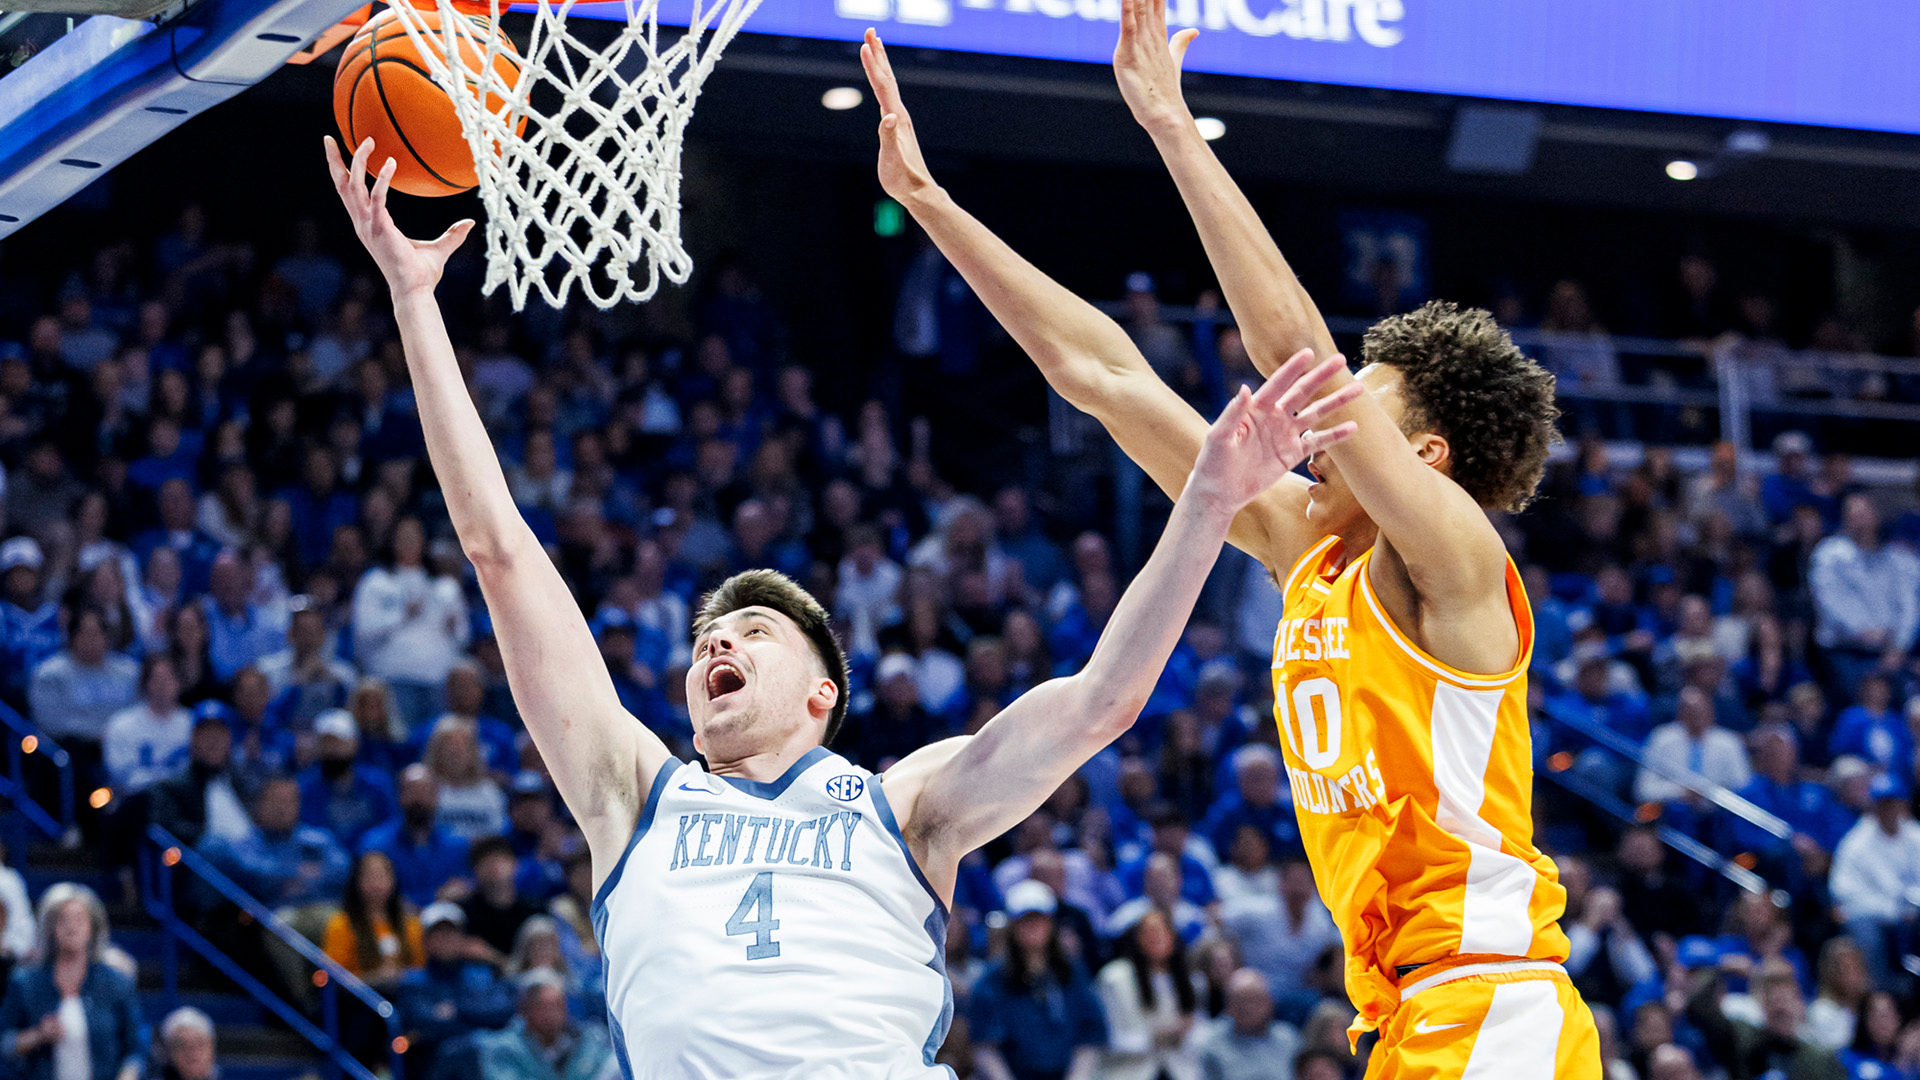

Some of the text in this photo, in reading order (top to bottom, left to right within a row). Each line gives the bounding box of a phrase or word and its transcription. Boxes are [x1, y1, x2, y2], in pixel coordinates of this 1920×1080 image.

[1277, 677, 1342, 770] 10
[827, 775, 863, 801] SEC
[670, 811, 862, 871] KENTUCKY
[725, 872, 780, 961] 4
